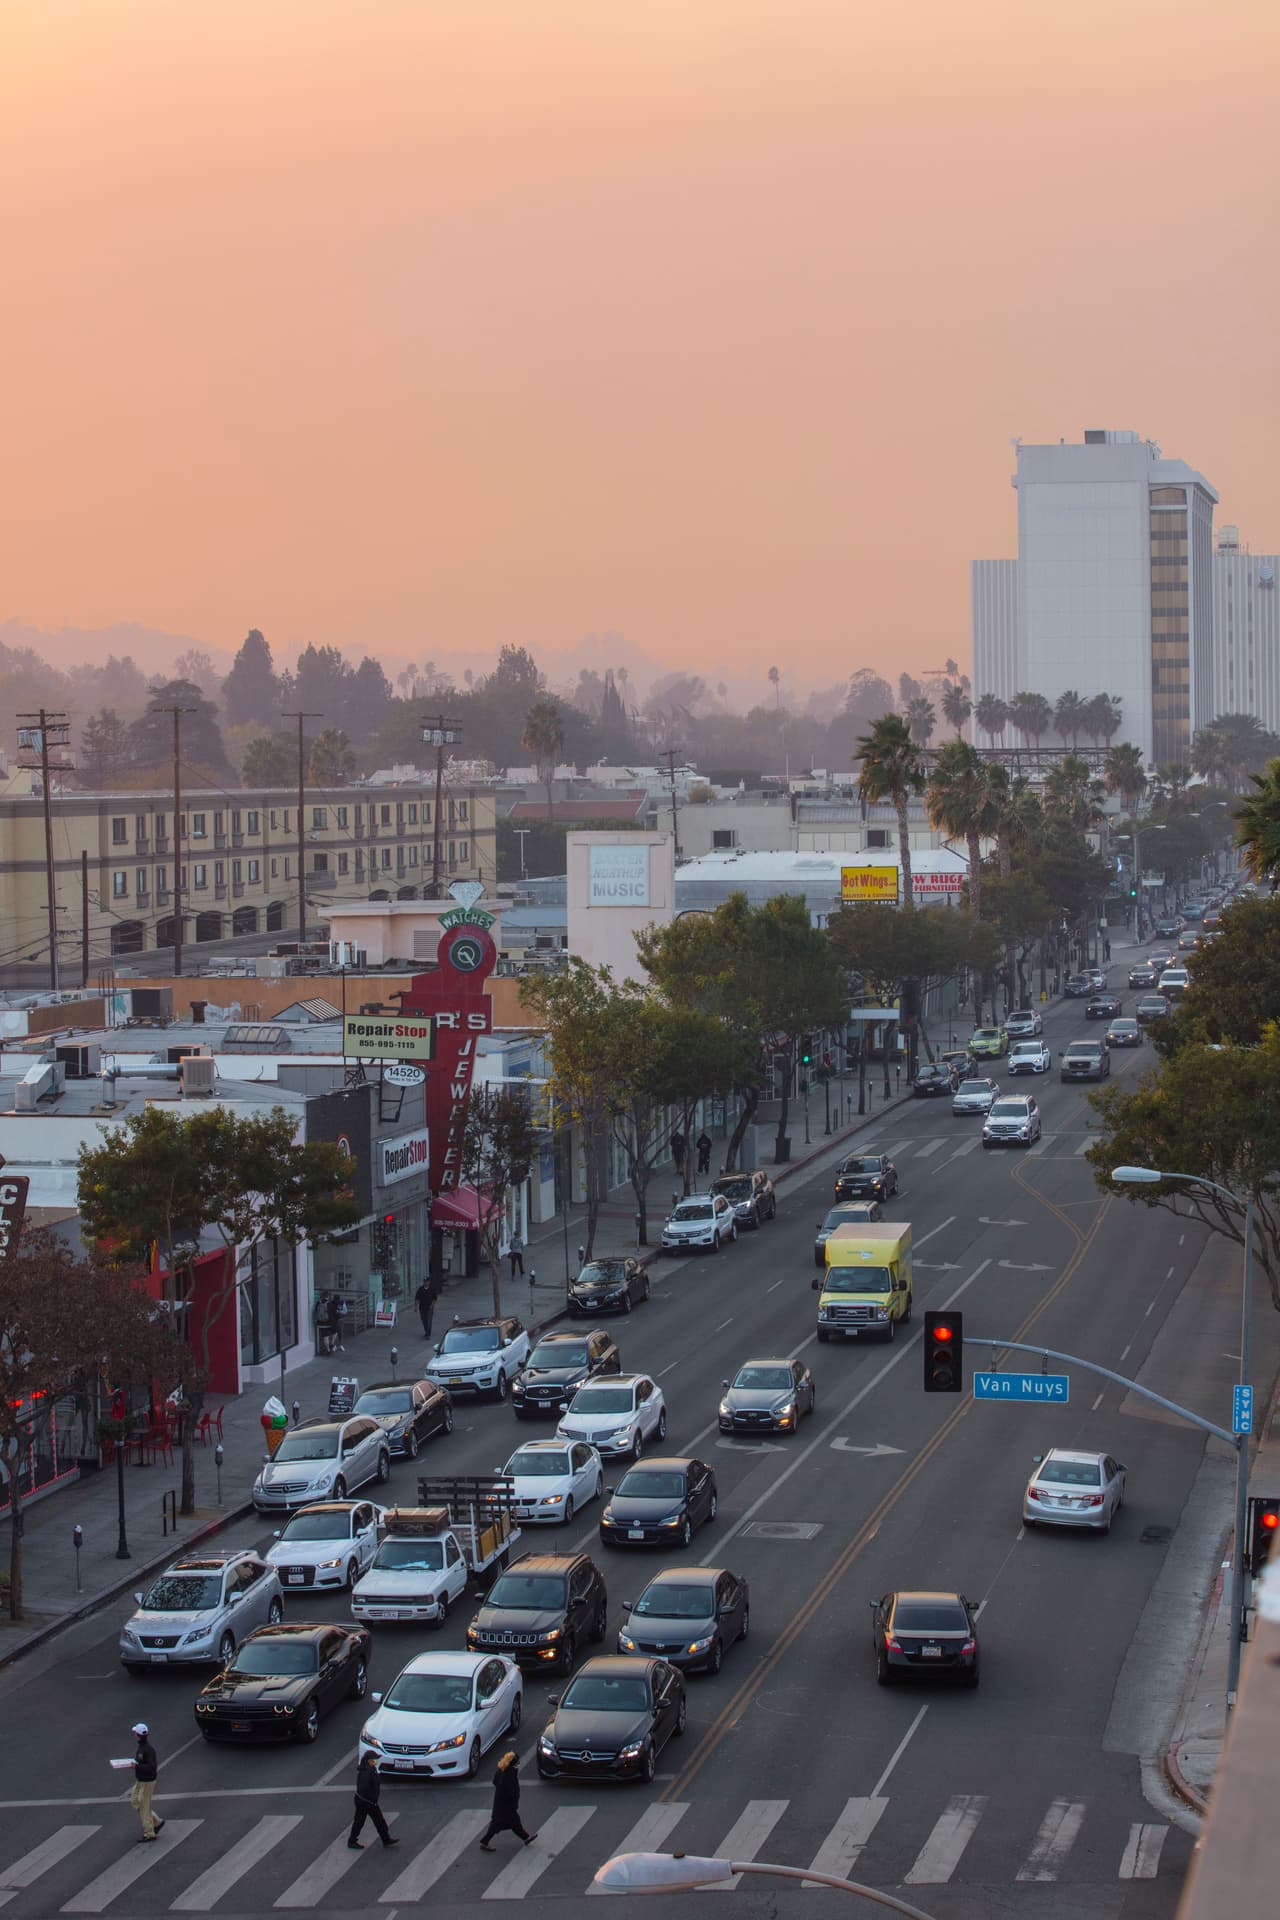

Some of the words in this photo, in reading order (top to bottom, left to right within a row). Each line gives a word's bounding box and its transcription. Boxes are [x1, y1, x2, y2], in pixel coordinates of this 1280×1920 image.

[593, 883, 645, 897] MUSIC
[443, 911, 493, 929] WATCHES
[389, 1067, 421, 1078] 14520
[980, 1377, 1011, 1392] Van
[1022, 1379, 1064, 1397] Nuys
[1241, 1388, 1250, 1431] SYNC
